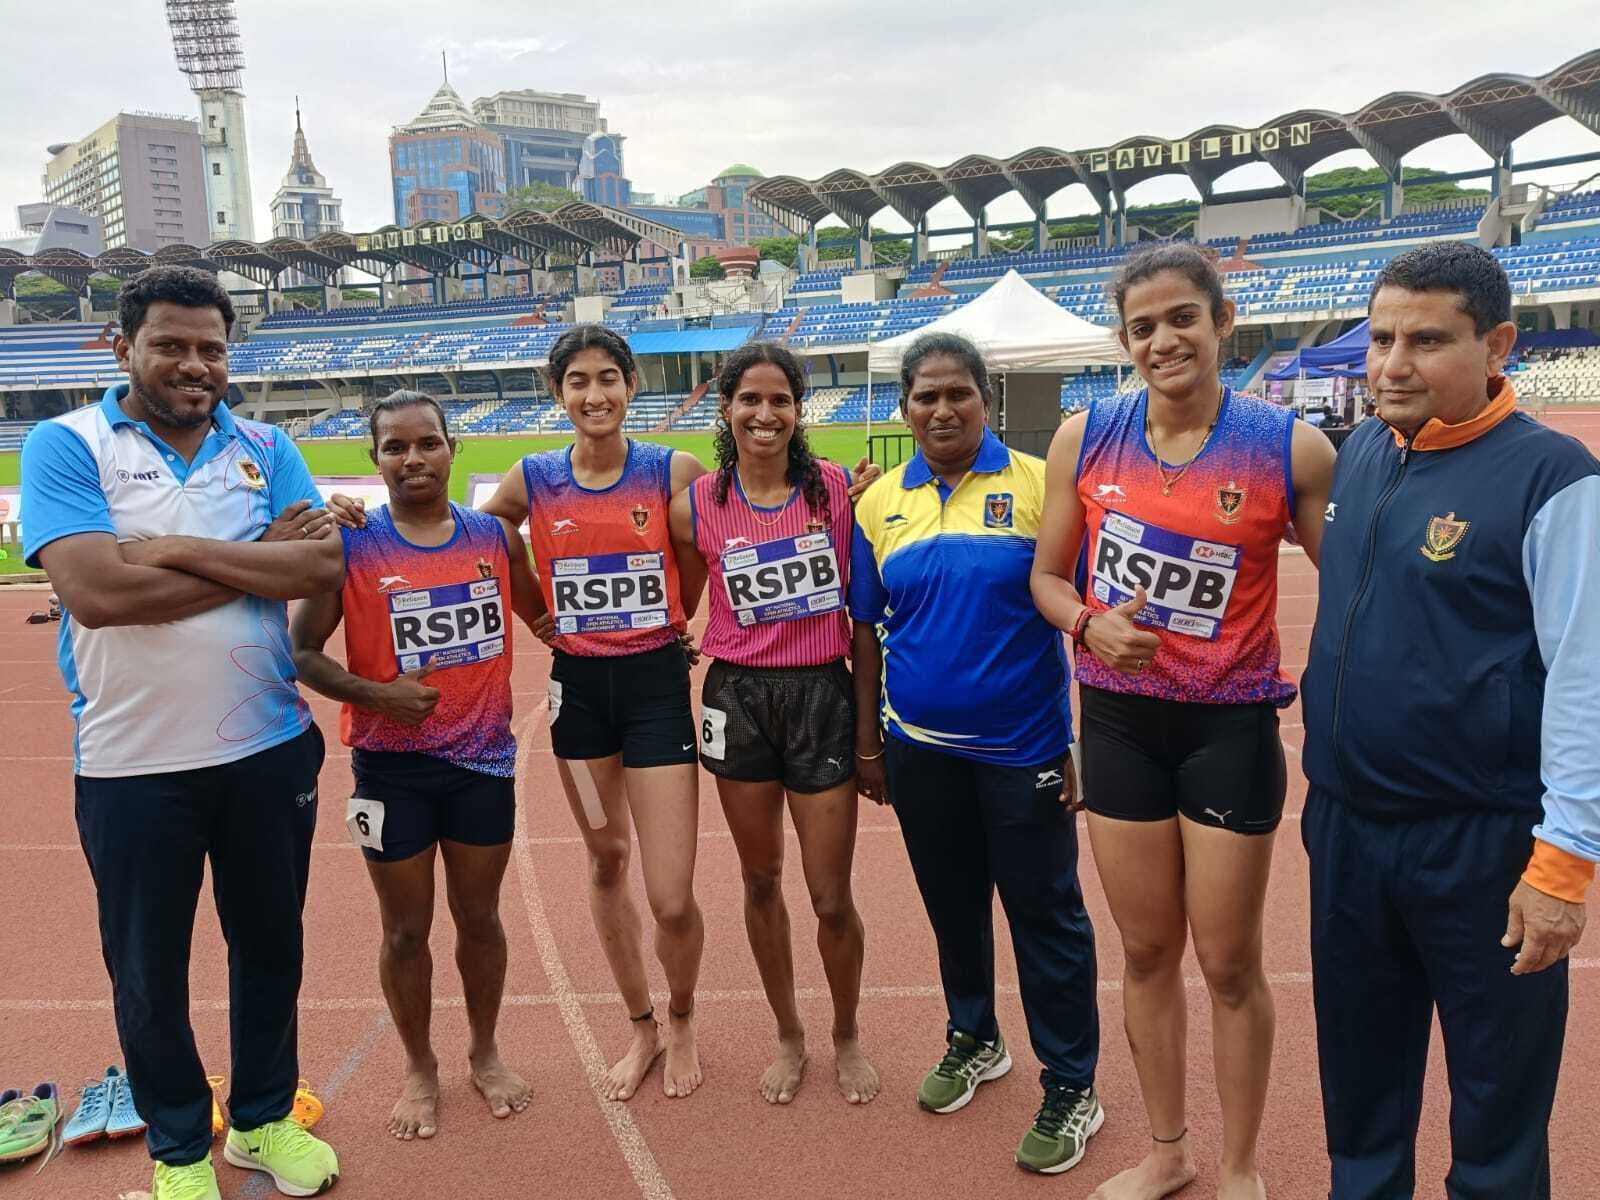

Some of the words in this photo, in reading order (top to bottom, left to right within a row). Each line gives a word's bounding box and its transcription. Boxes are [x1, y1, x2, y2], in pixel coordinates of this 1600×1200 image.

[1092, 125, 1309, 171] PAVILION
[555, 575, 663, 611] RSPB
[727, 555, 835, 605] RSPB
[1097, 537, 1226, 609] RSPB
[393, 602, 501, 650] RSPB
[703, 719, 713, 744] 6
[356, 811, 370, 836] 6
